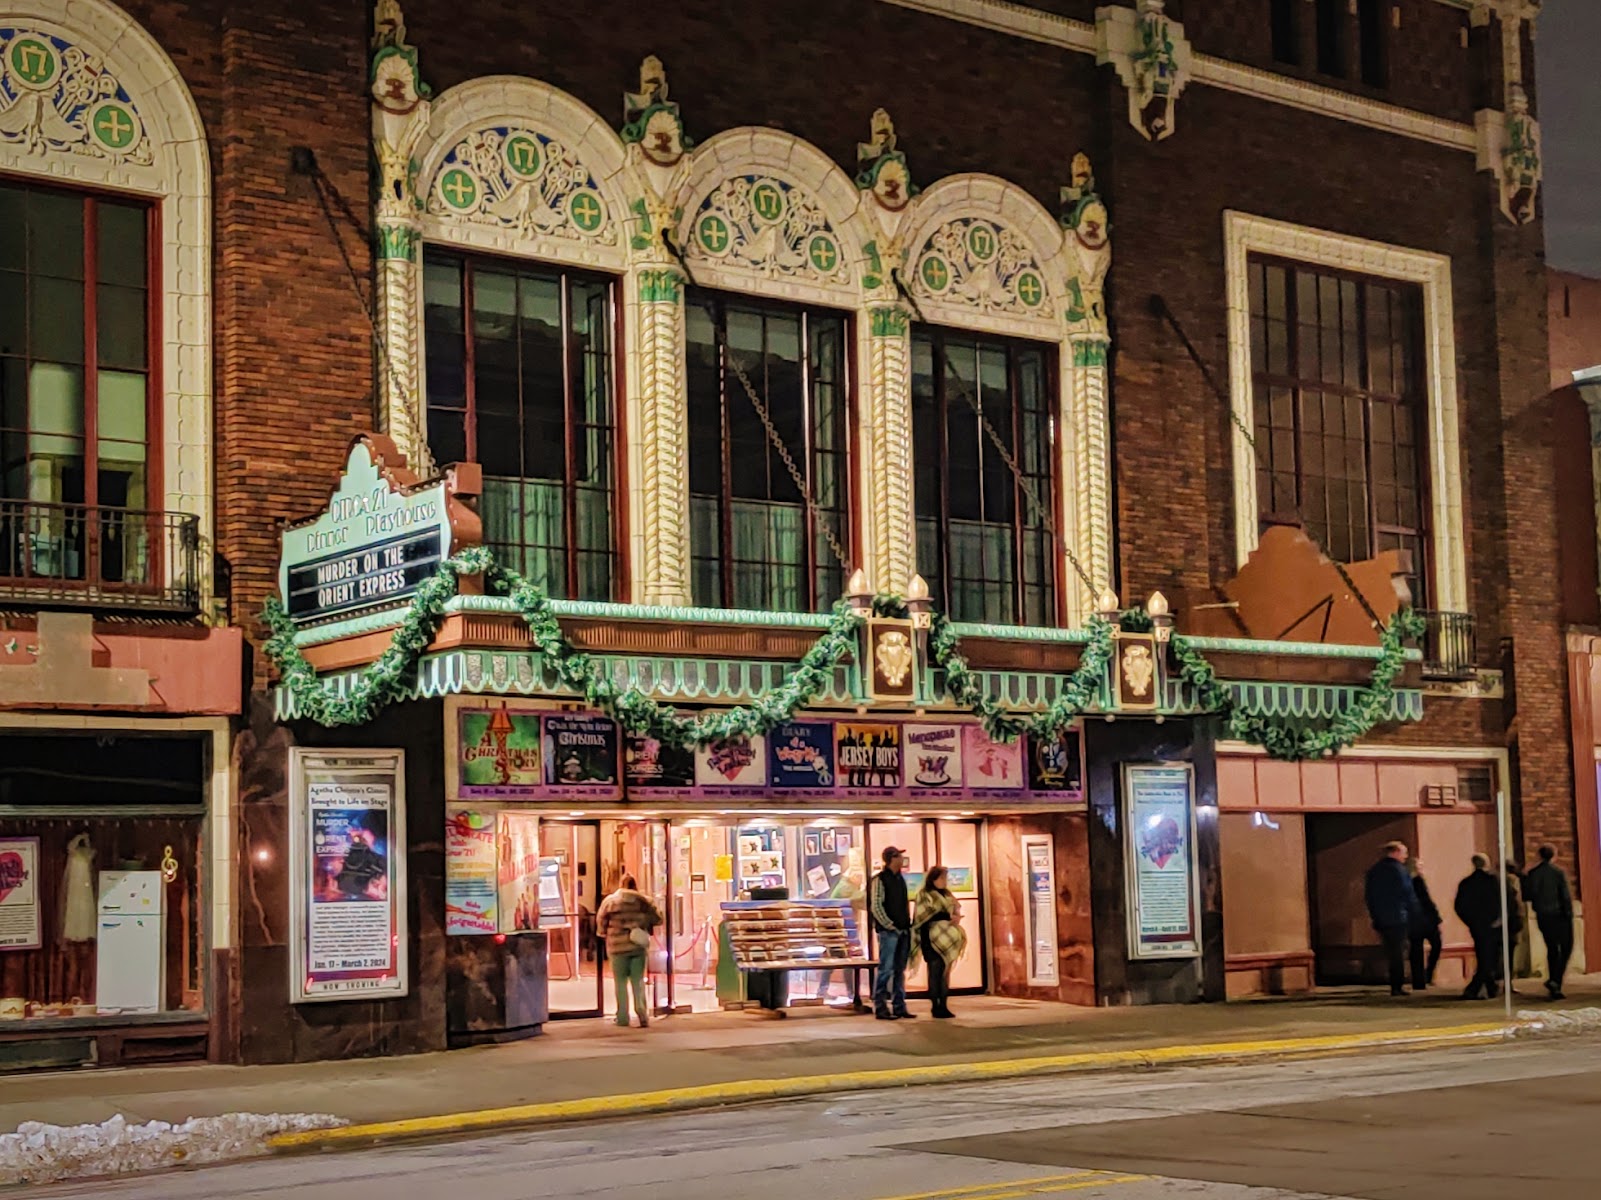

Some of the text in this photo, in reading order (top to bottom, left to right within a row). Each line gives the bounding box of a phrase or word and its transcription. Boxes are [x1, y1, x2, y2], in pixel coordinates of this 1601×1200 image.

[307, 501, 436, 554] Dinner Playhouse
[317, 545, 405, 585] MURDER ON THE
[318, 570, 406, 608] ORIENT EXPRESS
[839, 746, 874, 767] JERSEY
[875, 746, 899, 767] BOYS
[341, 959, 362, 968] March
[370, 958, 386, 967] 2024
